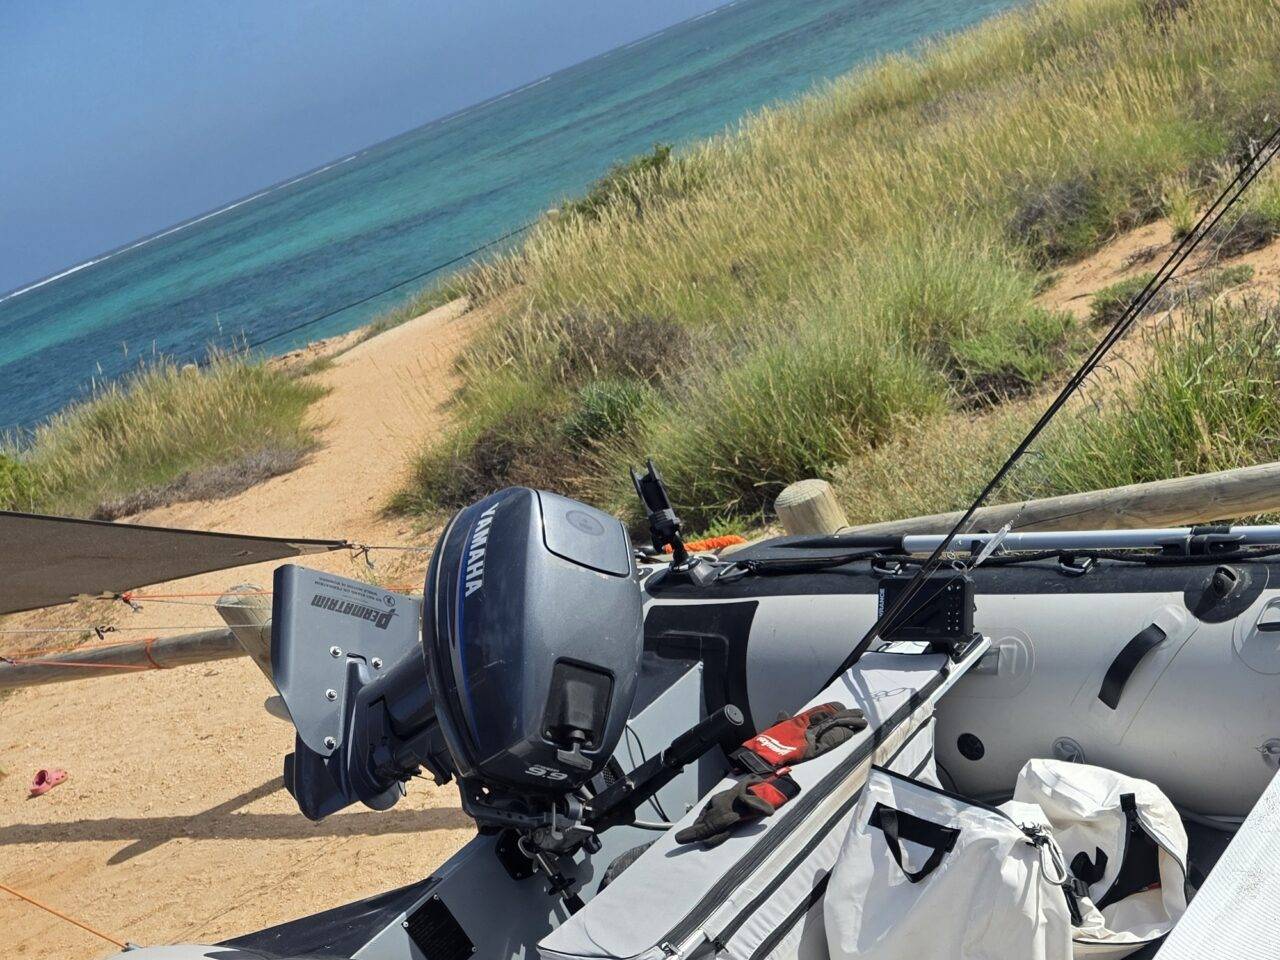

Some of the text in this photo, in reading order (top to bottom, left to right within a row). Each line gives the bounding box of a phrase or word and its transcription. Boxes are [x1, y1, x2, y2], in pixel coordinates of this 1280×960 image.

[465, 502, 500, 598] YAMAHA
[311, 595, 397, 630] PERMATRIM
[525, 767, 568, 780] 9.9
